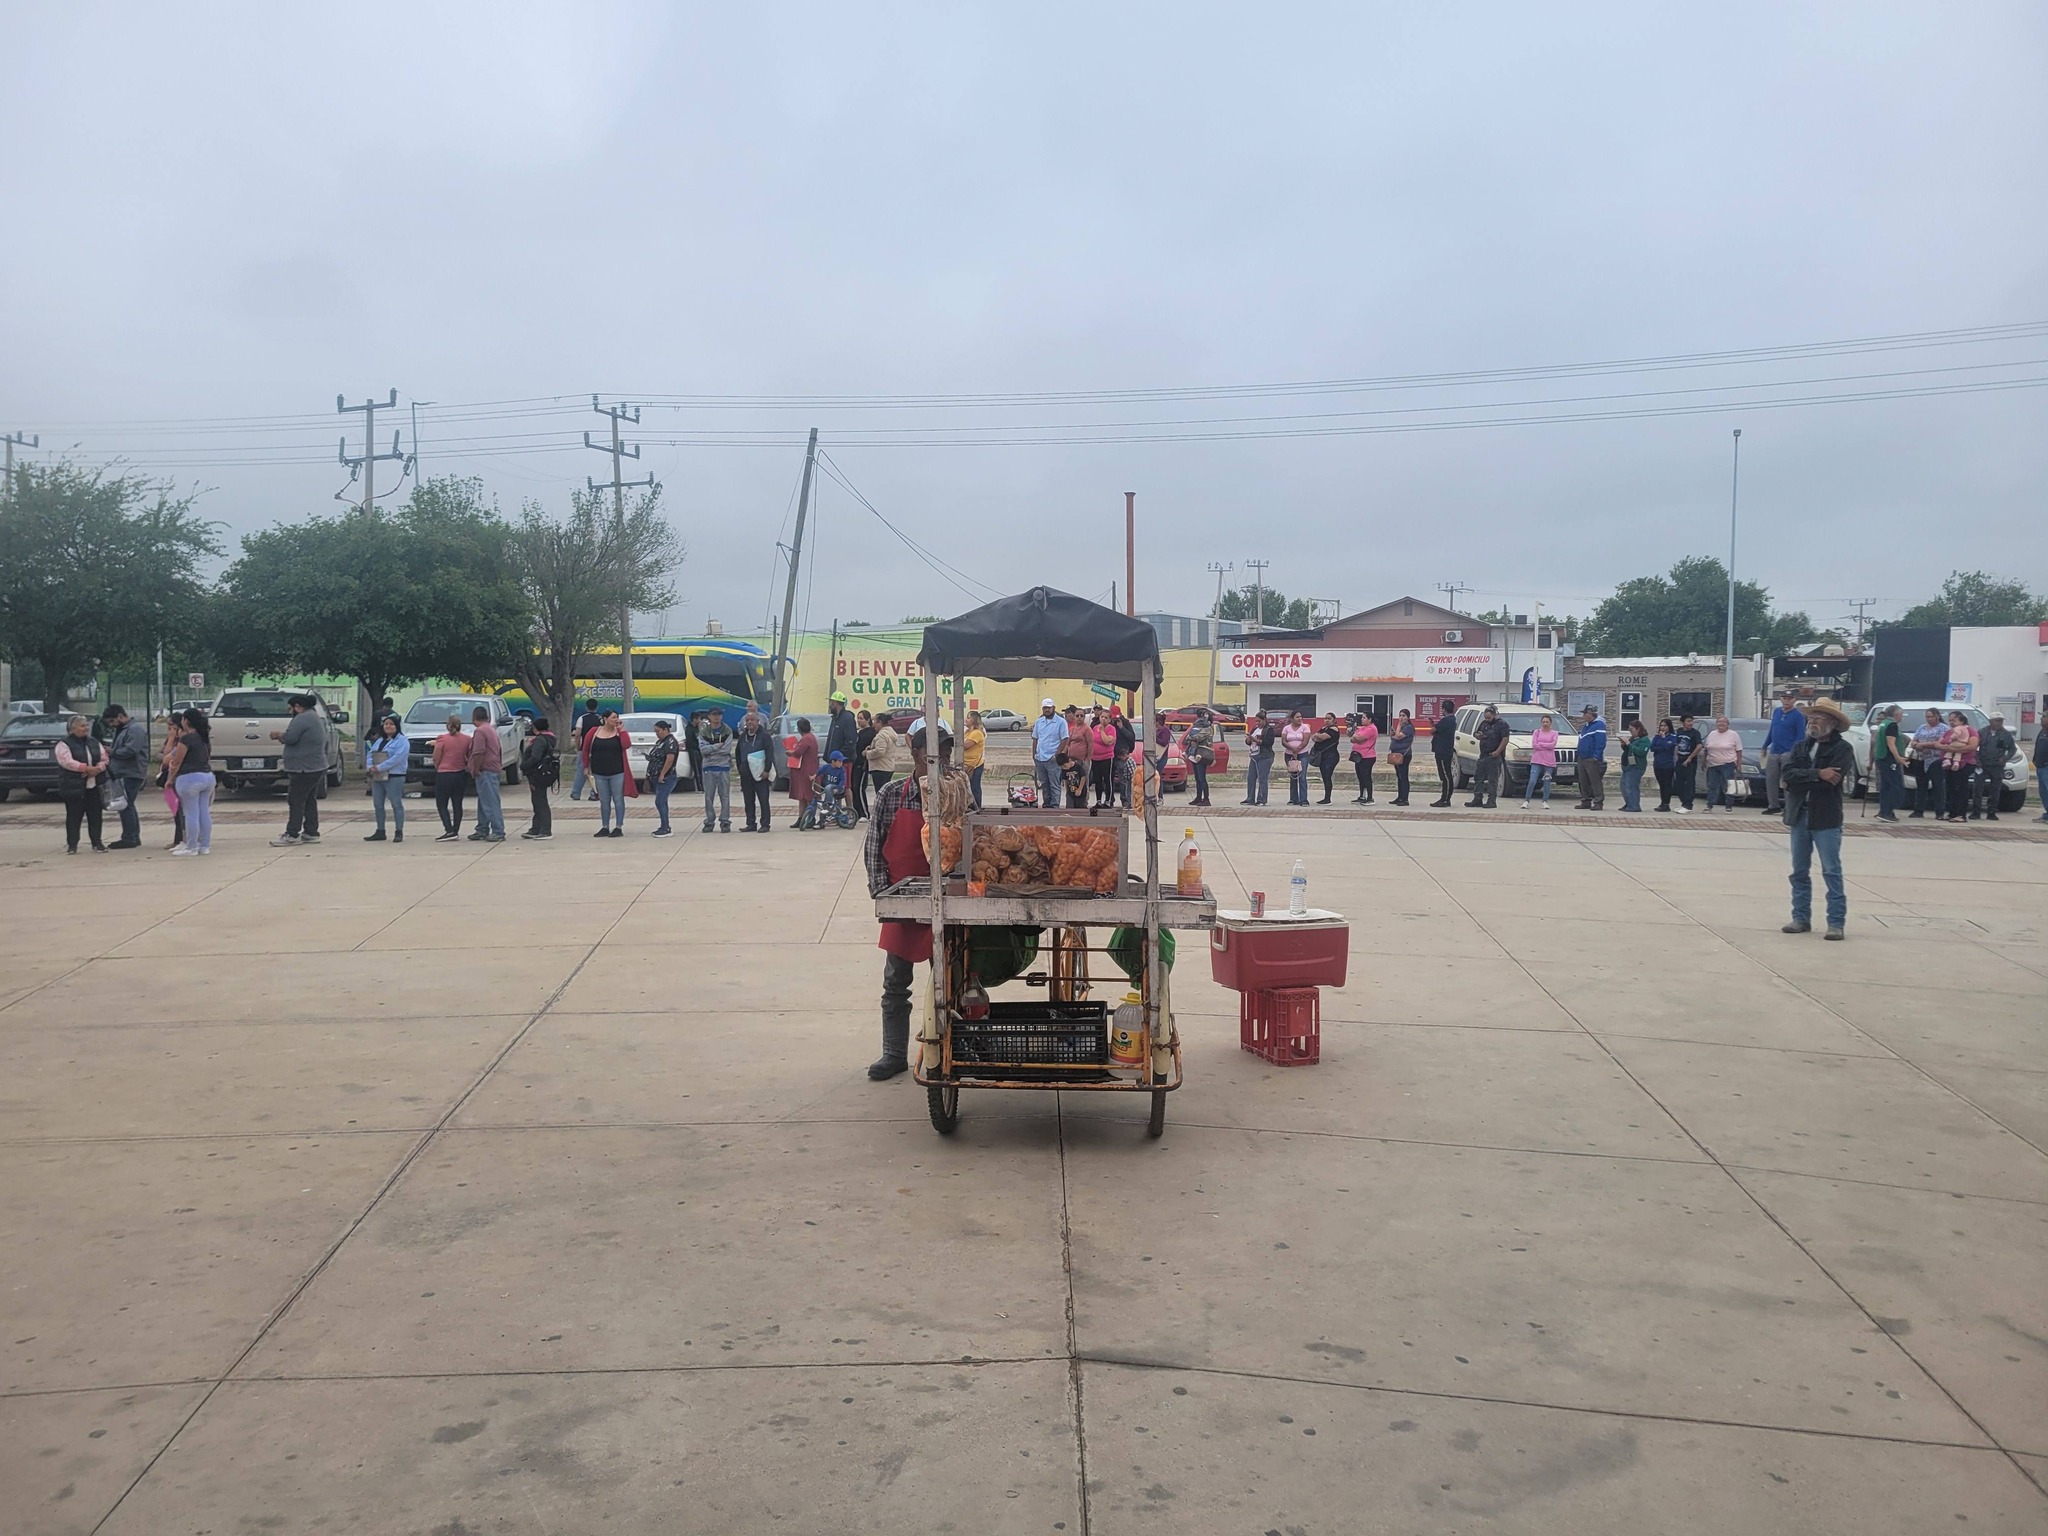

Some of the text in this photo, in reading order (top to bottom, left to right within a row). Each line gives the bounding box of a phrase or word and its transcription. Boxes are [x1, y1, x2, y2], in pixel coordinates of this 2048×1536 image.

[1232, 653, 1312, 668] GORDITAS
[1425, 655, 1453, 664] SERVICIO
[1458, 655, 1490, 664] DOMICILIO
[1245, 670, 1259, 678] LA
[1618, 676, 1647, 684] ROME
[852, 678, 974, 694] GUARDRA
[592, 686, 640, 698] ESTREA
